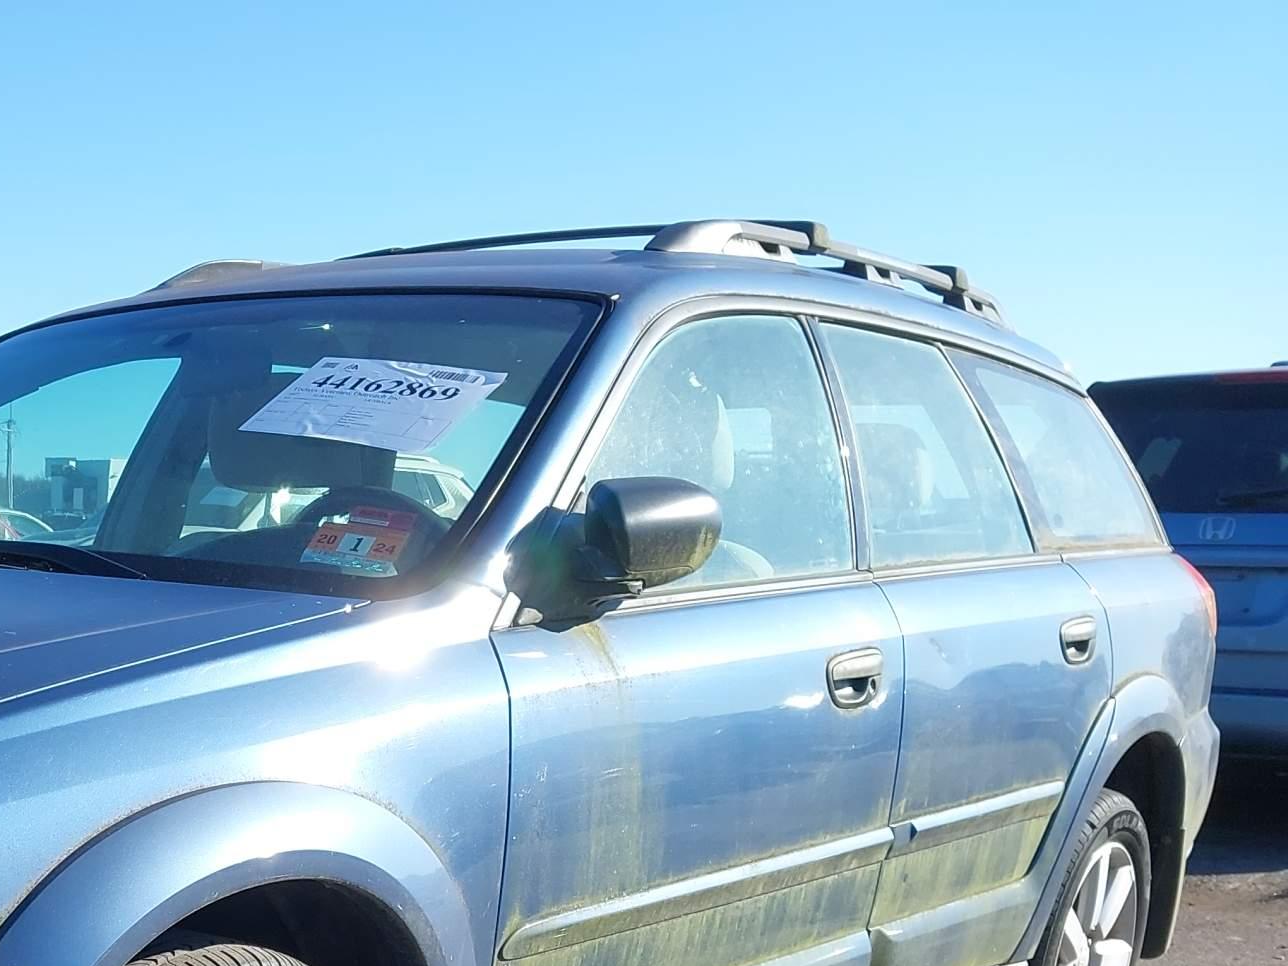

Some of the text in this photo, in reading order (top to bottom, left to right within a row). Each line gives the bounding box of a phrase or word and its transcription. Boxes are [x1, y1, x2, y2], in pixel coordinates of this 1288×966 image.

[312, 374, 461, 401] 44162869
[317, 534, 396, 555] 20 1 24
